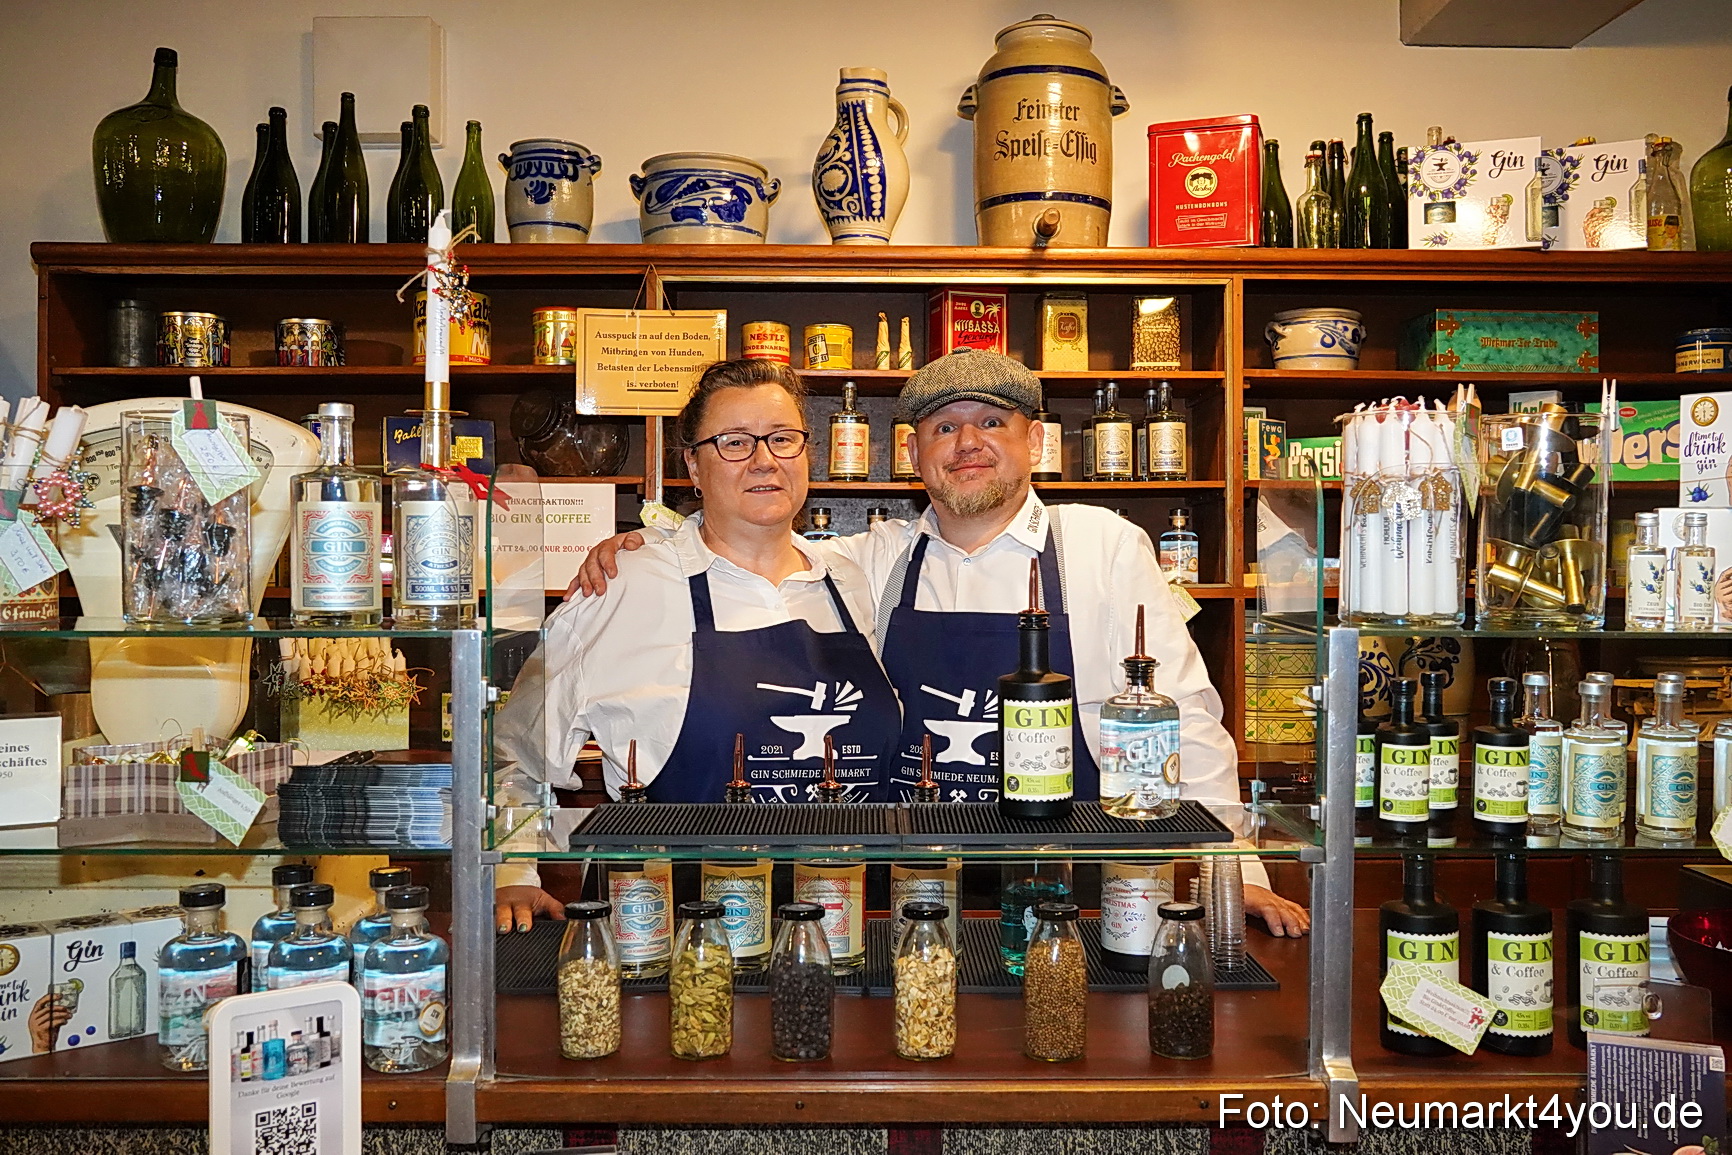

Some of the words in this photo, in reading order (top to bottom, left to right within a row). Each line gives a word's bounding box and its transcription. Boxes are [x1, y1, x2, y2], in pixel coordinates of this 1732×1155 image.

[1167, 148, 1236, 168] Rachengold
[1488, 150, 1526, 179] Gin
[1591, 153, 1629, 182] Gin
[1175, 201, 1228, 210] HUSTENBONBONS
[595, 331, 648, 342] Ausspucken
[649, 332, 663, 341] auf
[664, 332, 681, 341] den
[682, 332, 711, 341] Boden,
[601, 347, 649, 358] Mitbringen
[650, 349, 667, 357] von
[668, 348, 705, 358] Hunden,
[597, 362, 635, 372] Betasten
[636, 363, 652, 372] der
[639, 380, 680, 389] verboten!
[1261, 423, 1283, 433] Fewa
[1694, 431, 1712, 442] time
[1684, 431, 1727, 458] drink
[86, 455, 97, 464] 900
[105, 450, 116, 458] 800
[1696, 457, 1718, 475] gin
[507, 498, 584, 506] IHNACHTSAKTION!!!
[490, 514, 507, 523] BIO
[510, 514, 532, 523] GIN
[535, 514, 543, 523] &
[546, 514, 592, 523] COFFEE
[323, 541, 353, 552] GIN
[431, 547, 451, 555] GIN
[545, 545, 561, 553] NUR
[562, 545, 586, 553] 20,00
[414, 585, 436, 593] 500ML
[2, 605, 12, 620] 6
[12, 605, 41, 622] feine
[1014, 706, 1069, 728] GIN
[1006, 731, 1015, 742] &
[1017, 730, 1056, 744] Coffee
[760, 745, 784, 754] 2021
[842, 745, 861, 754] ESTD
[909, 744, 924, 754] 202
[990, 752, 999, 760] ES
[1126, 733, 1171, 763] GIN
[1391, 749, 1431, 764] GIN
[1437, 740, 1458, 755] IN
[1484, 750, 1528, 765] GIN
[751, 770, 770, 779] GIN
[771, 768, 820, 779] SCHMIEDE
[900, 766, 915, 775] GIN
[1384, 767, 1390, 775] &
[1394, 767, 1423, 778] Coffee
[1478, 766, 1484, 775] &
[1486, 766, 1517, 778] Coffee
[1597, 783, 1615, 791] GIN
[632, 903, 656, 914] GIN
[1111, 921, 1122, 929] GIN
[64, 940, 104, 973] Gin
[1399, 940, 1456, 962] GIN
[1502, 941, 1552, 962] GIN
[1593, 941, 1649, 963] GIN
[1491, 964, 1501, 975] &
[1506, 964, 1545, 978] Coffee
[1583, 963, 1592, 975] &
[1597, 964, 1639, 978] Coffee
[0, 981, 11, 991] me
[0, 979, 30, 1006] ink
[374, 986, 421, 1015] GIN
[0, 1006, 17, 1022] in
[238, 1090, 259, 1098] Danke
[261, 1086, 270, 1094] für
[271, 1083, 289, 1092] deine
[291, 1077, 324, 1087] Bewertung
[276, 1089, 300, 1100] Google
